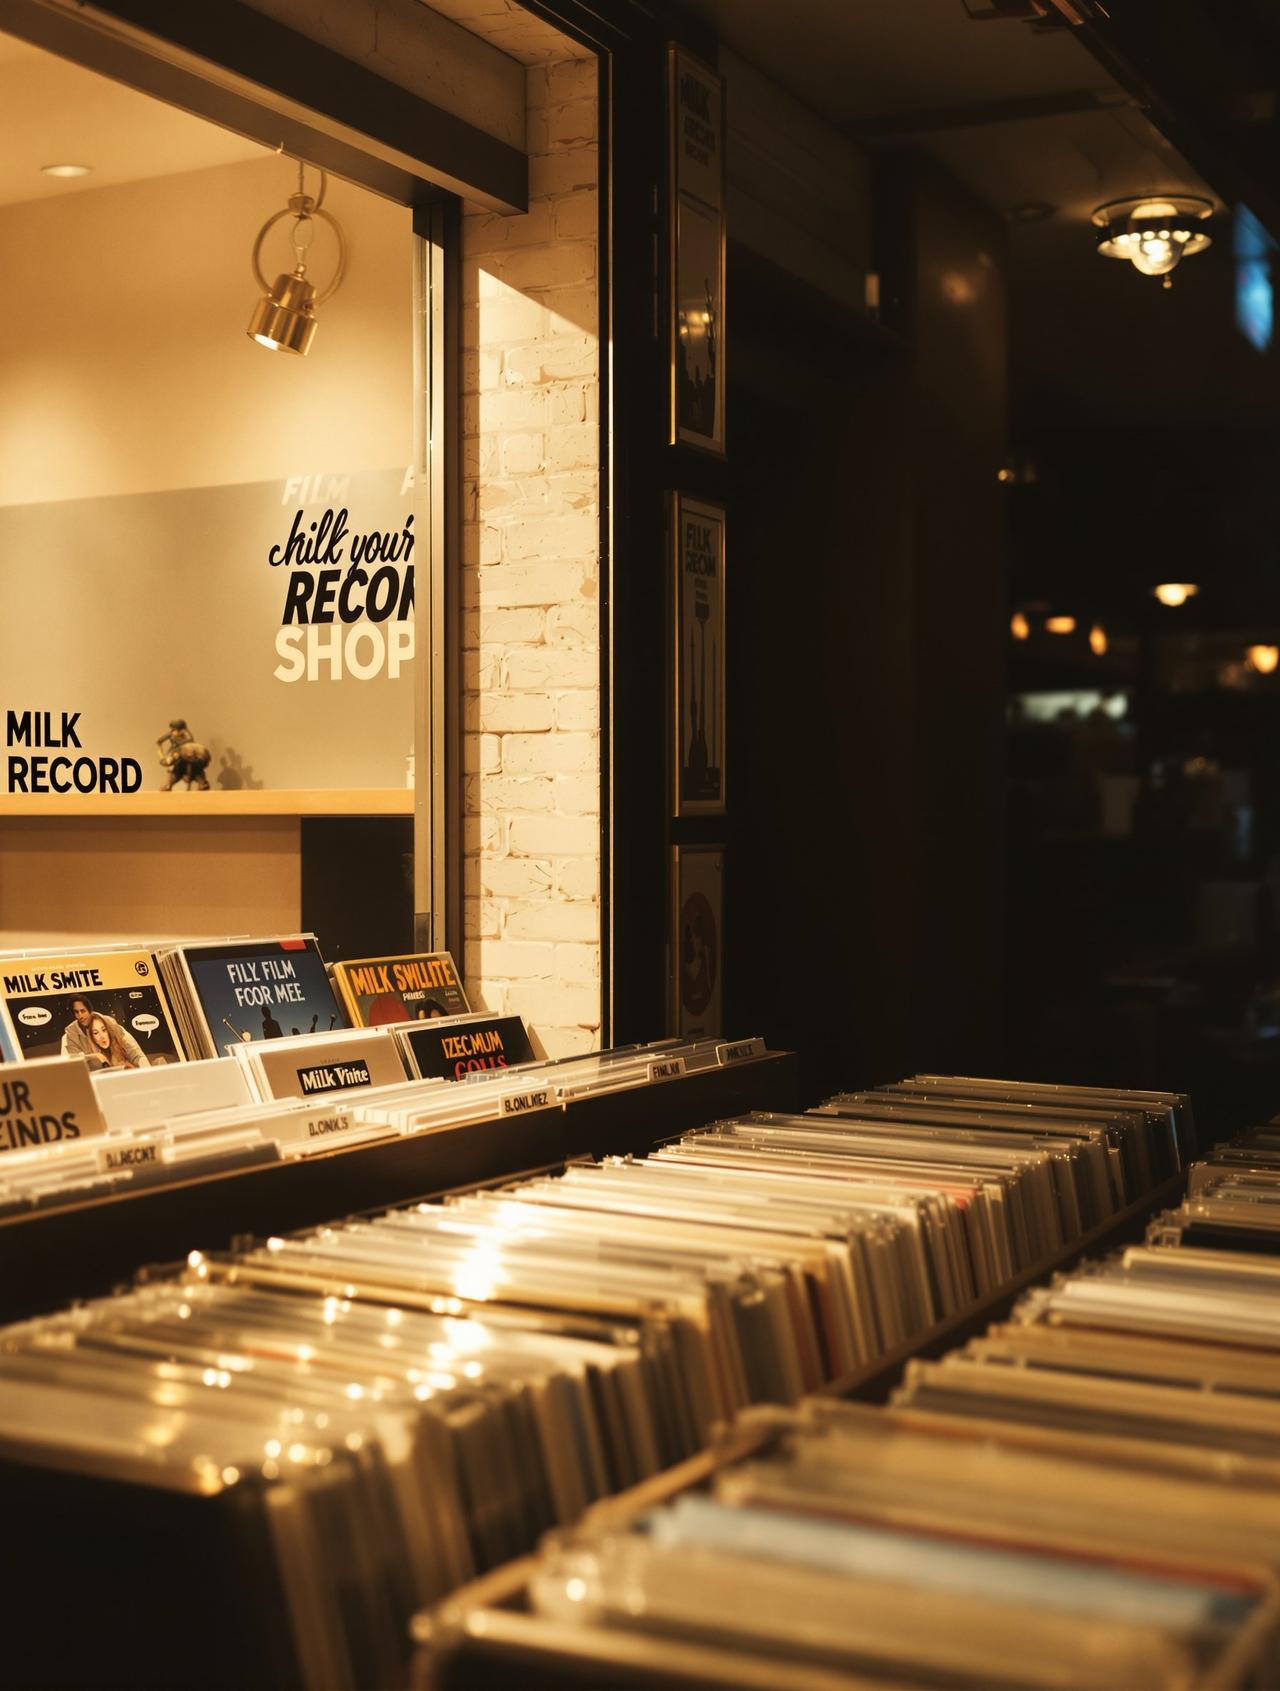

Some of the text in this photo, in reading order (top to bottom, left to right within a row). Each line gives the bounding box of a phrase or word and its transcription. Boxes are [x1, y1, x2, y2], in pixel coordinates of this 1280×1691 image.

[273, 620, 415, 683] SHOP
[6, 710, 82, 748] MILK
[8, 756, 143, 793] RECORD
[3, 969, 103, 994] MILK SMITE
[261, 960, 296, 981] FILM
[350, 966, 395, 995] MILK
[234, 983, 306, 1007] FOOR MEE
